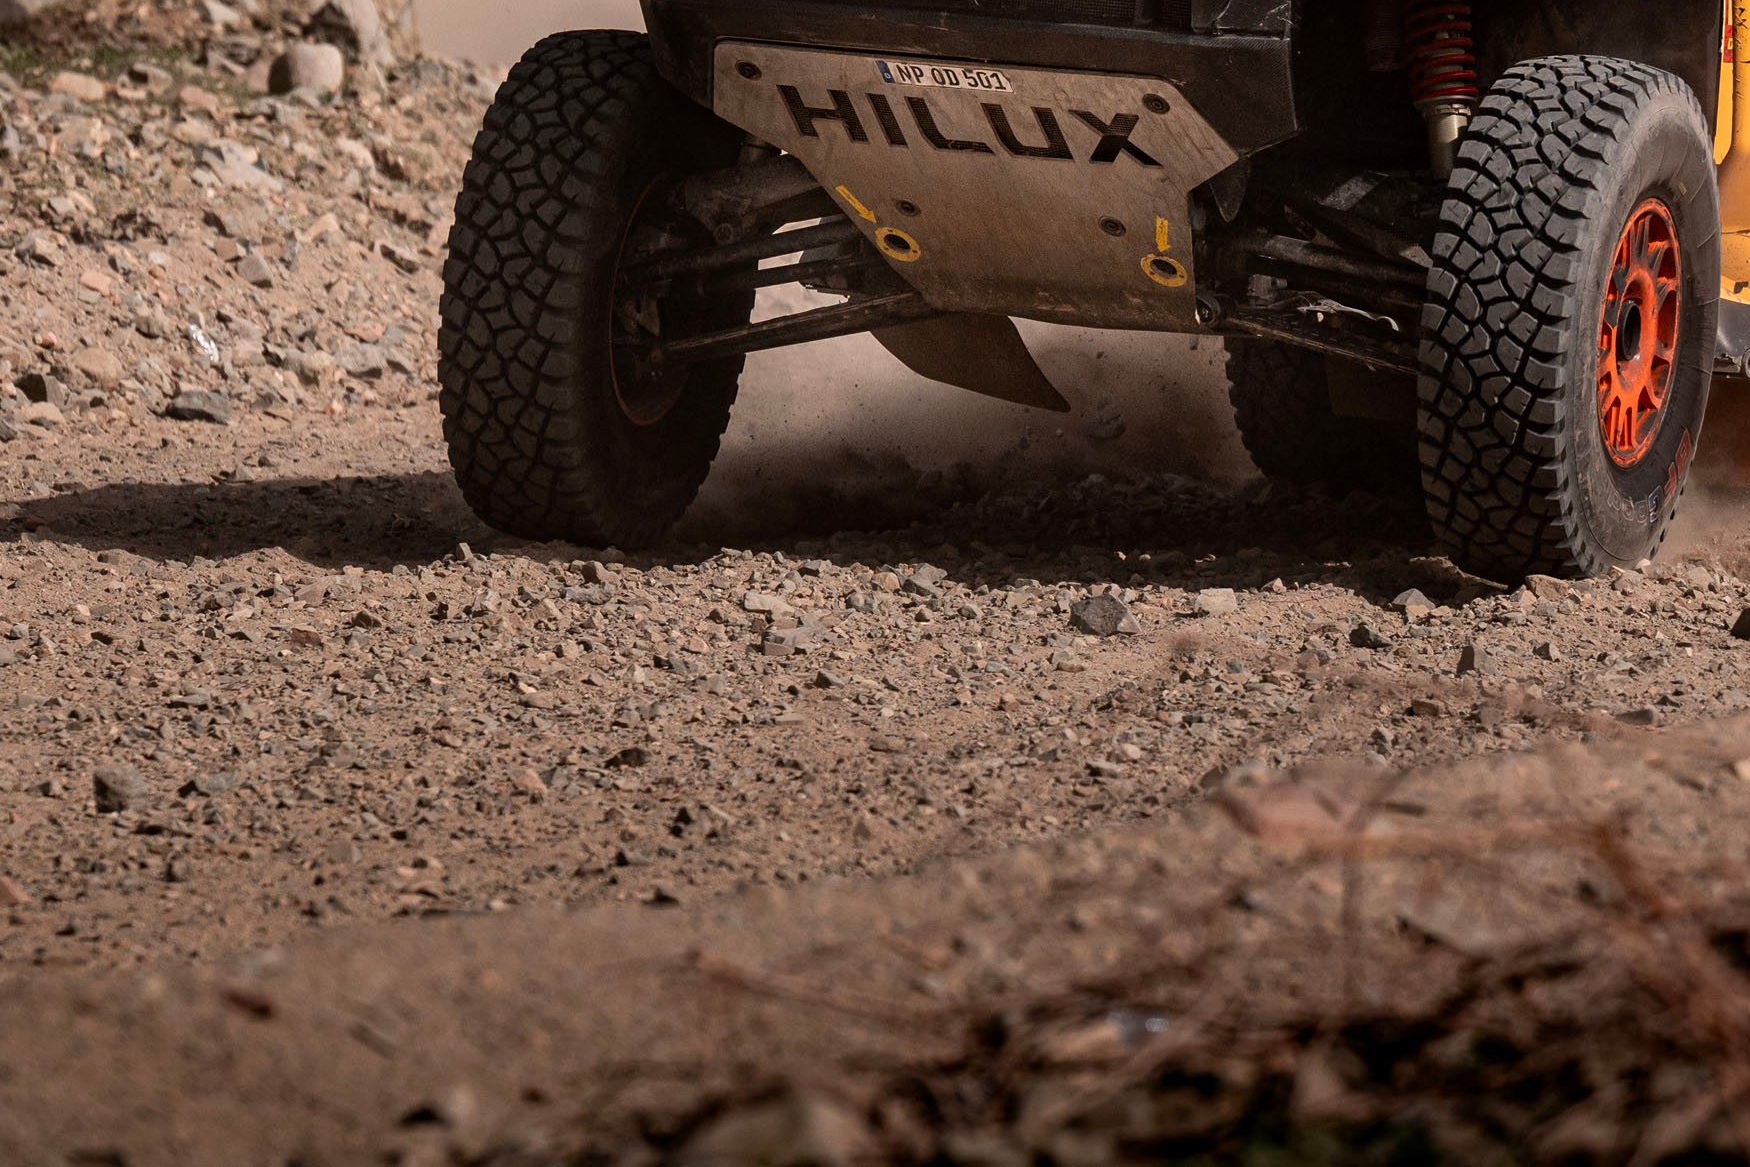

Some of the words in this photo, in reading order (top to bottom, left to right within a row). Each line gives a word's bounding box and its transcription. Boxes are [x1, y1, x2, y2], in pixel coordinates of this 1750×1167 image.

[896, 64, 924, 83] NP
[931, 67, 960, 86] OD
[962, 69, 1007, 90] 501
[776, 83, 1163, 168] HILUX
